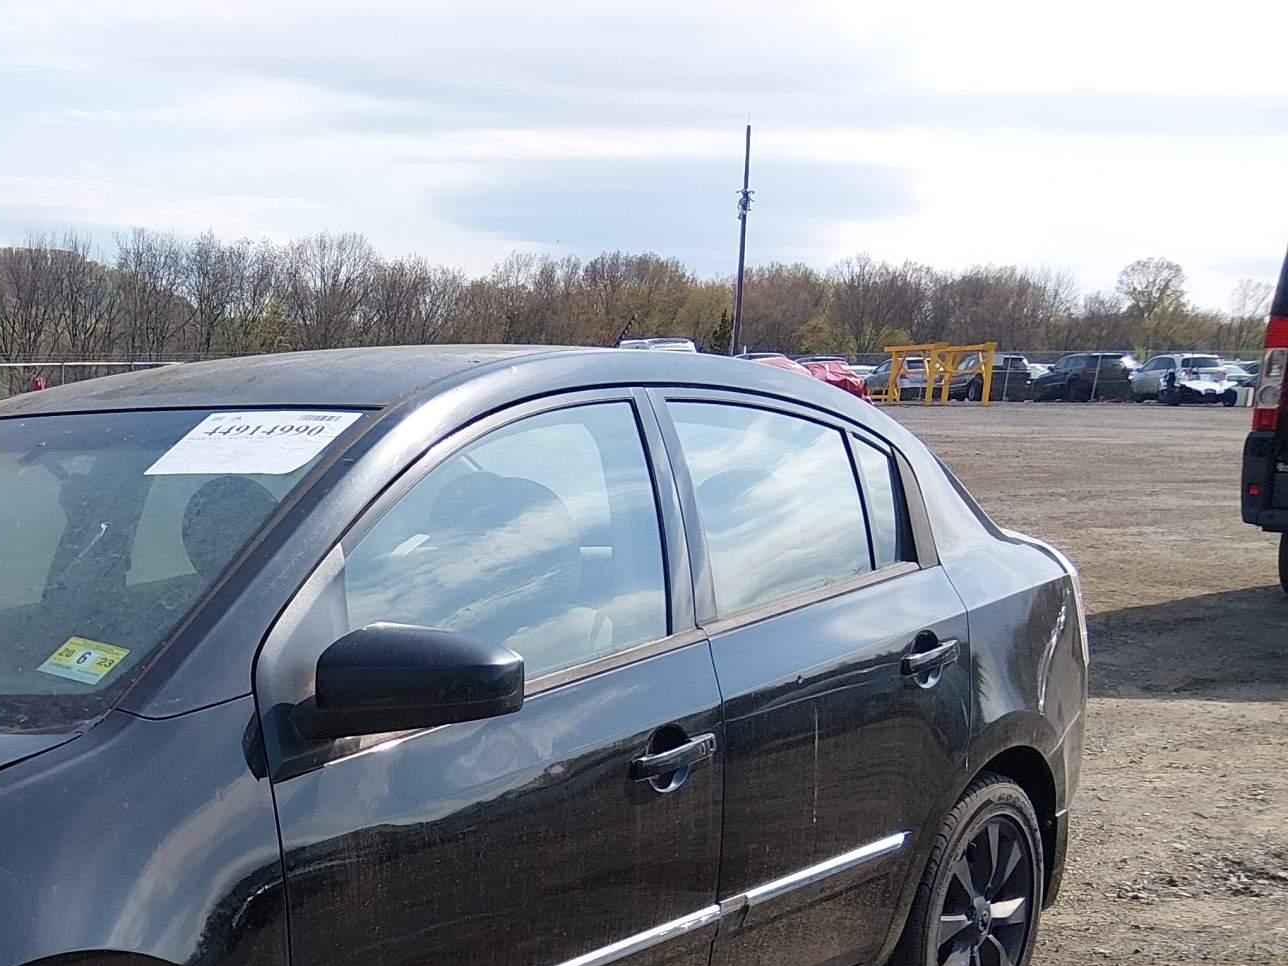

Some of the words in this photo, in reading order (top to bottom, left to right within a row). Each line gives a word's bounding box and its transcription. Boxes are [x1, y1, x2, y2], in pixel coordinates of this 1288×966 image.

[203, 424, 326, 436] 44914990
[58, 648, 76, 658] 20
[76, 651, 92, 665] 6
[96, 657, 115, 668] 23
